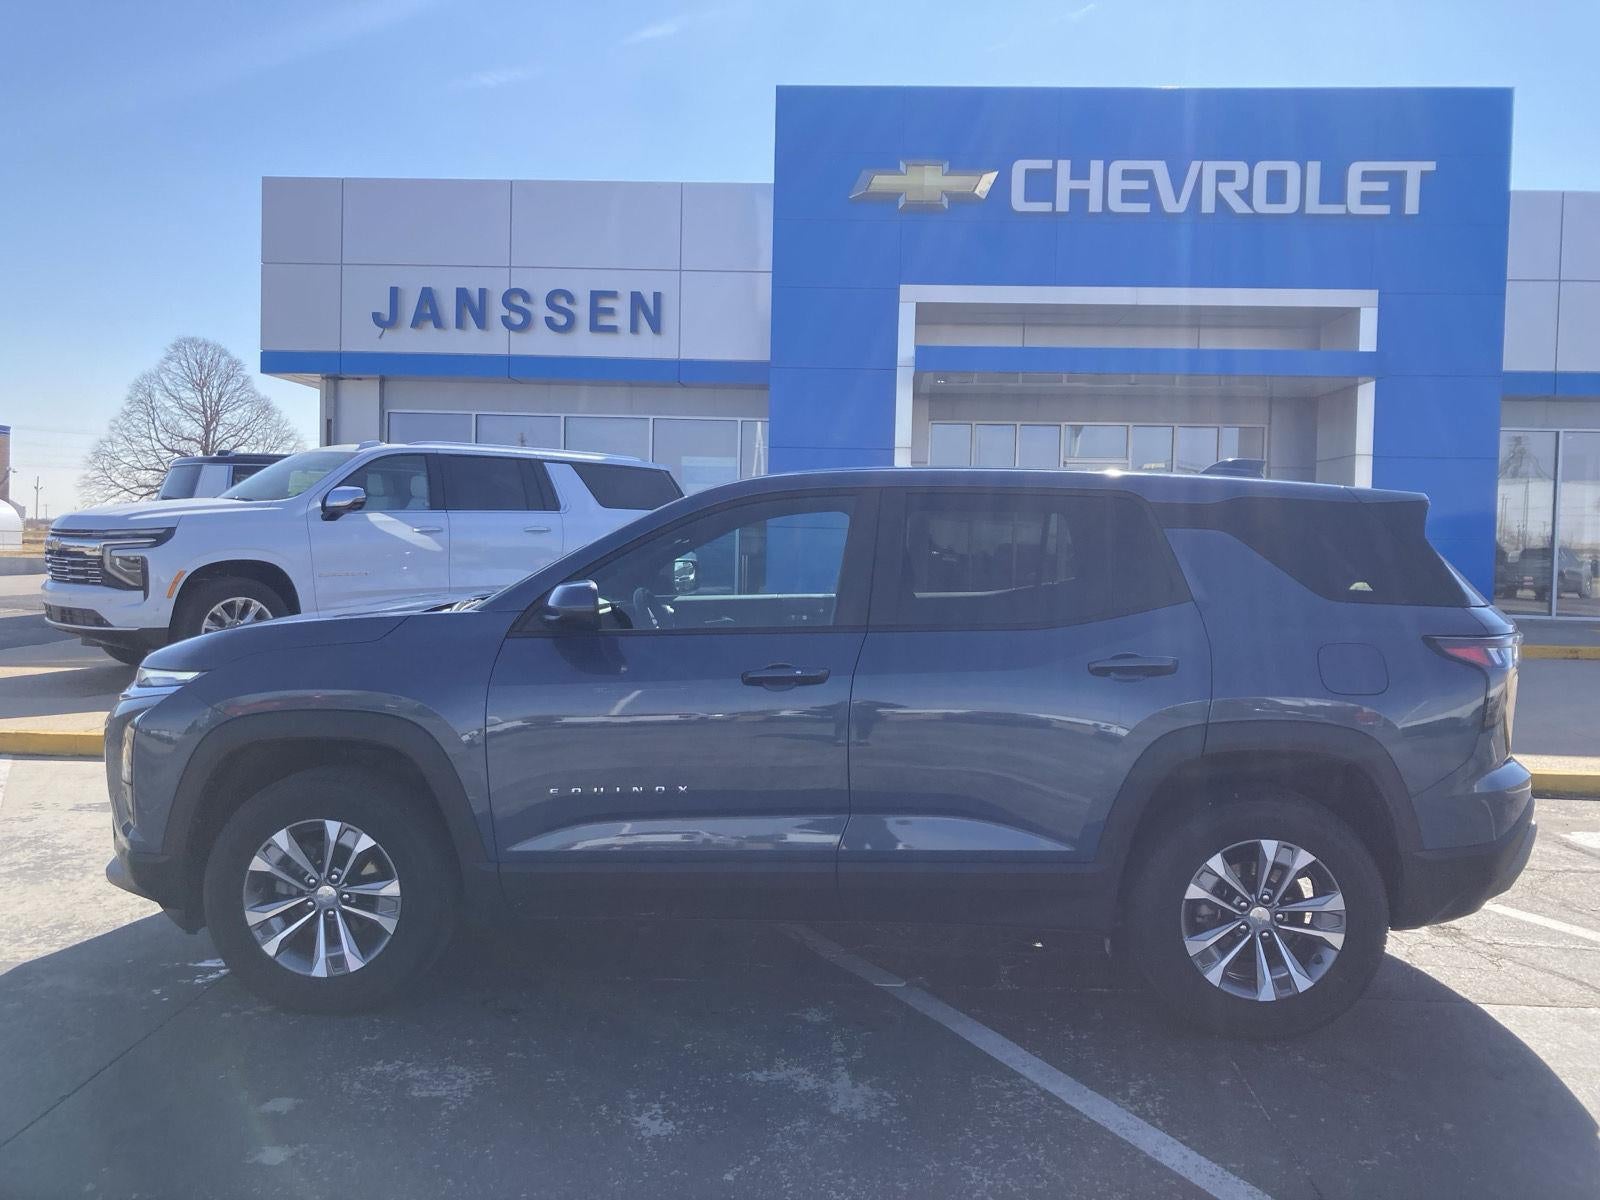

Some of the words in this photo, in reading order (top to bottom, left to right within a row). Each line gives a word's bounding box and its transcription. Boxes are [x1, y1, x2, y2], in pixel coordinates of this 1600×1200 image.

[1011, 159, 1436, 215] CHEVROLET
[371, 286, 663, 335] JANSSEN
[549, 785, 688, 795] EQUINOX
